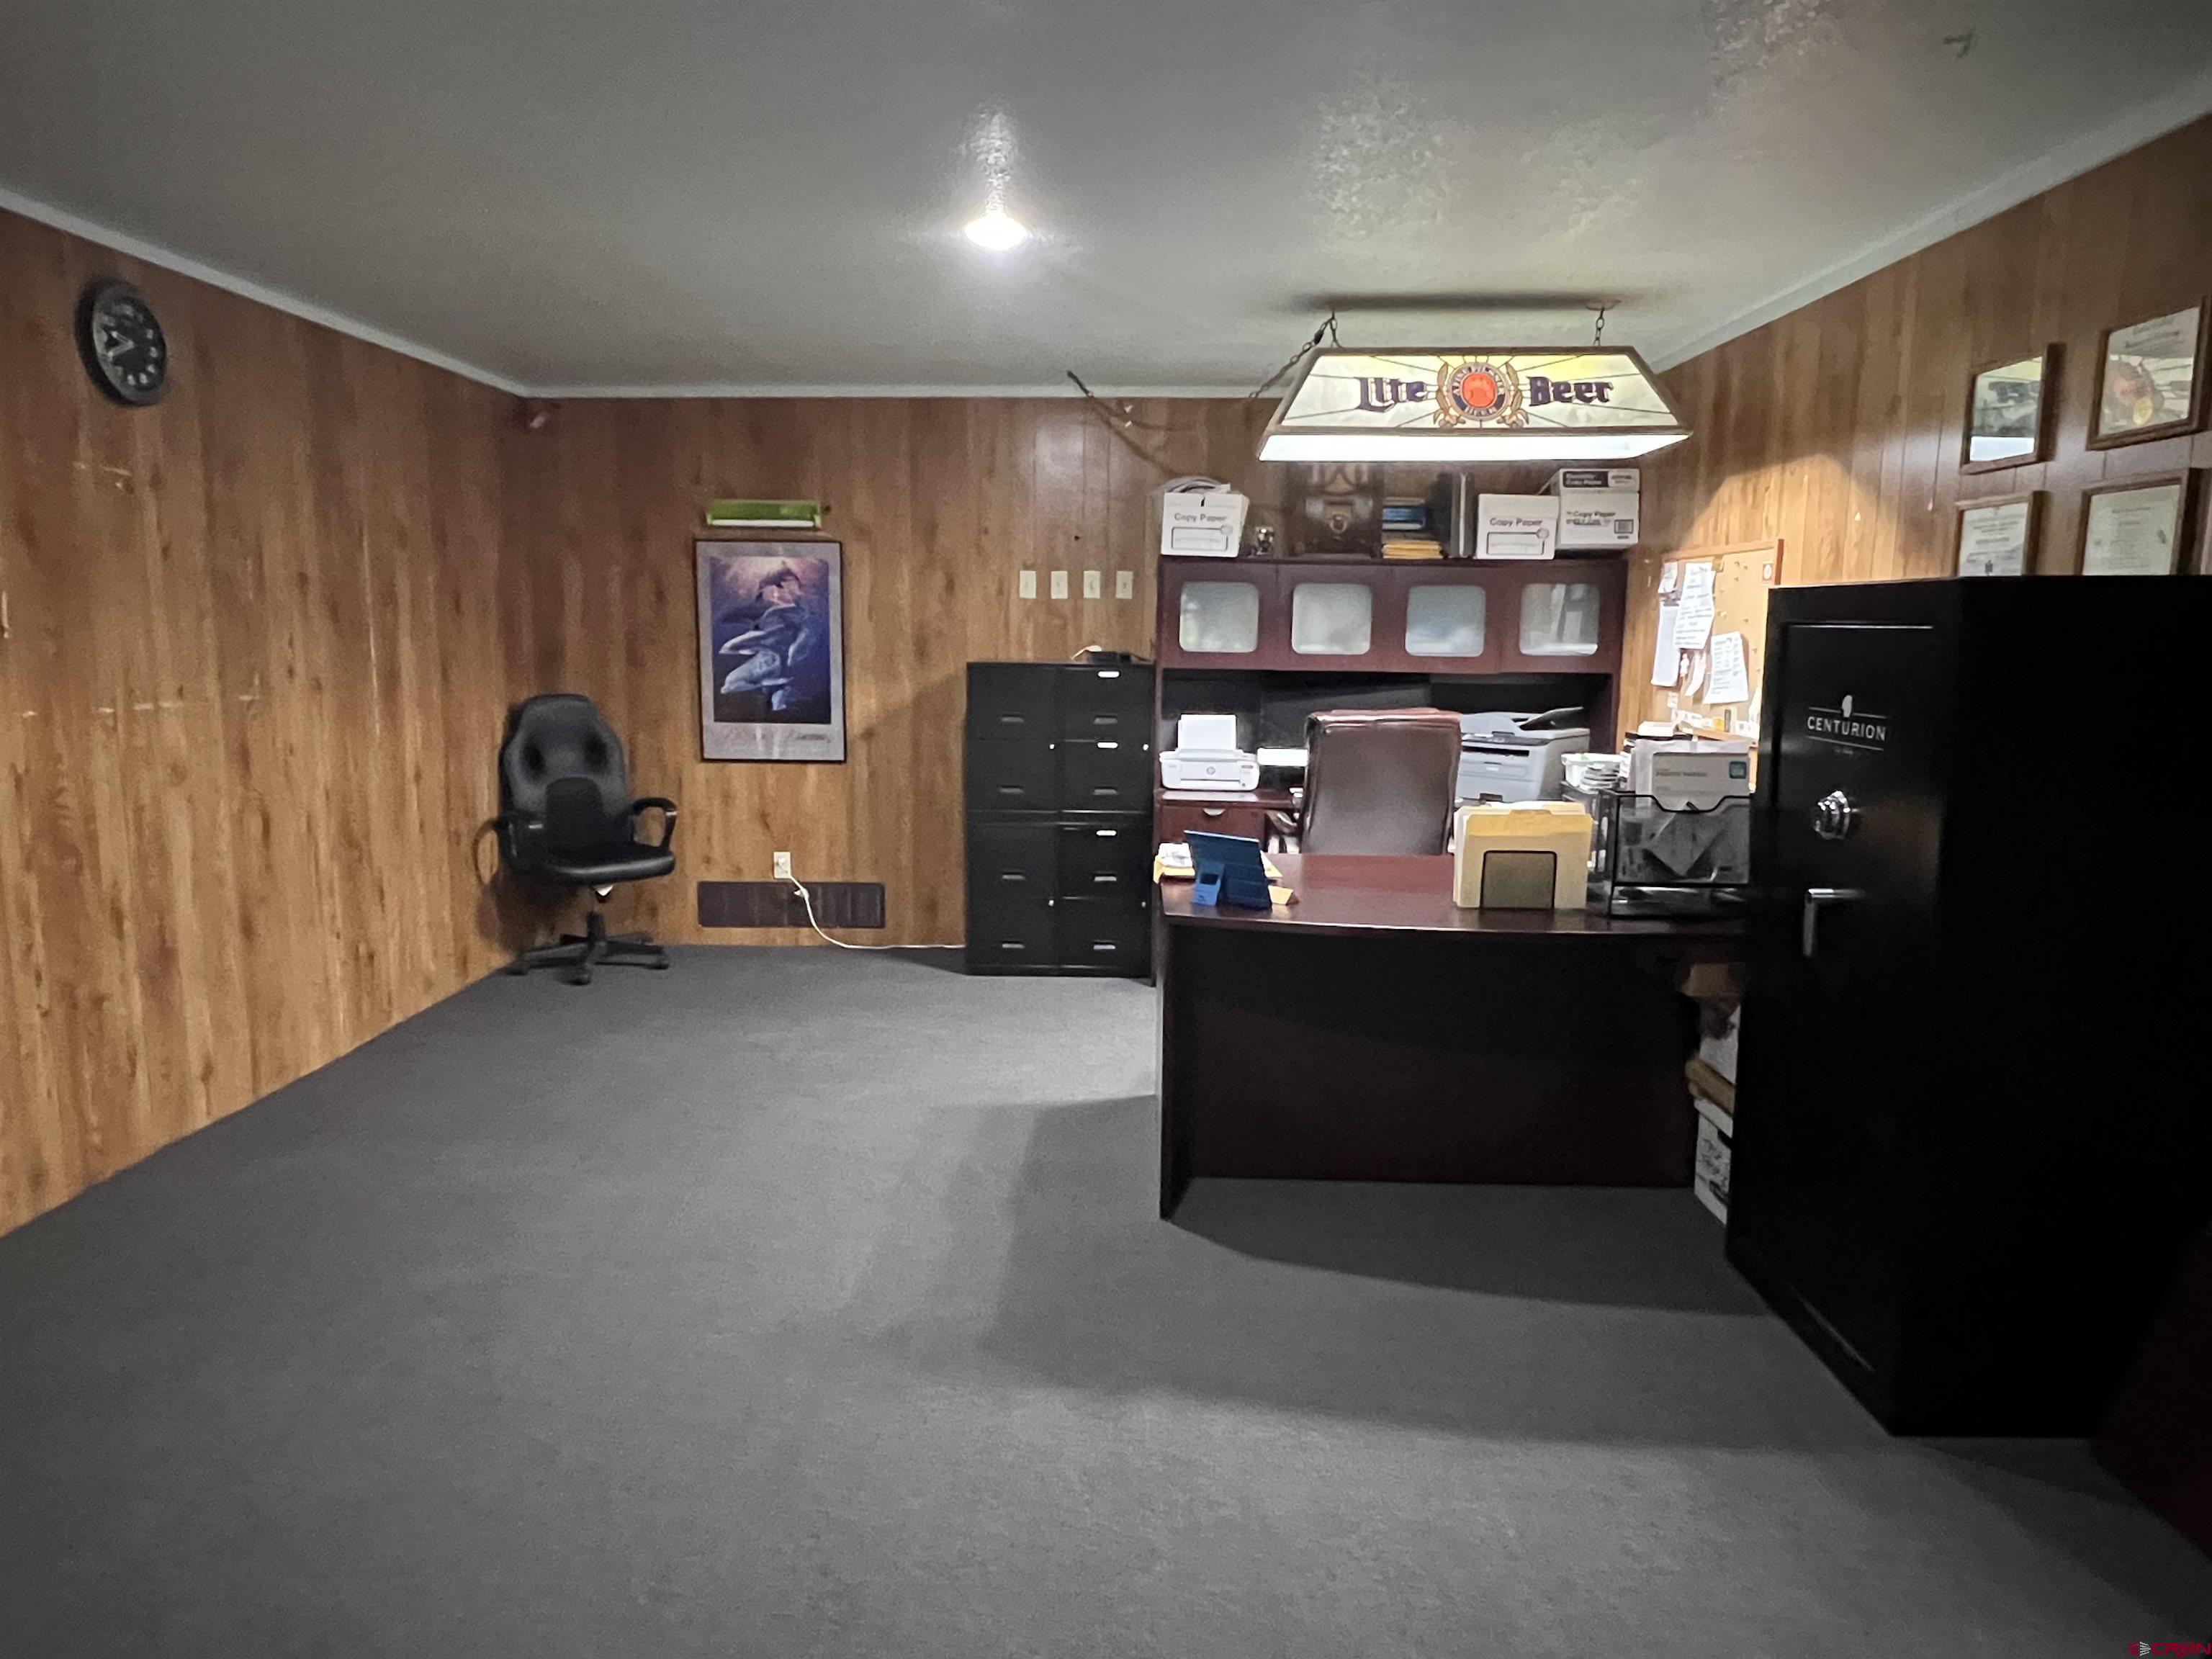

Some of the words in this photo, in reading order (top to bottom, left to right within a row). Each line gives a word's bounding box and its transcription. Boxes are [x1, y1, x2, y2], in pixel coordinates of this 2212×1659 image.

[1354, 377, 1427, 413] Lite
[1526, 376, 1614, 407] Beer
[1174, 513, 1197, 522] Copy
[1200, 513, 1227, 523] Paper
[1490, 518, 1513, 526] Copy
[1516, 518, 1542, 526] Paper
[1807, 716, 1886, 741] CENTURION
